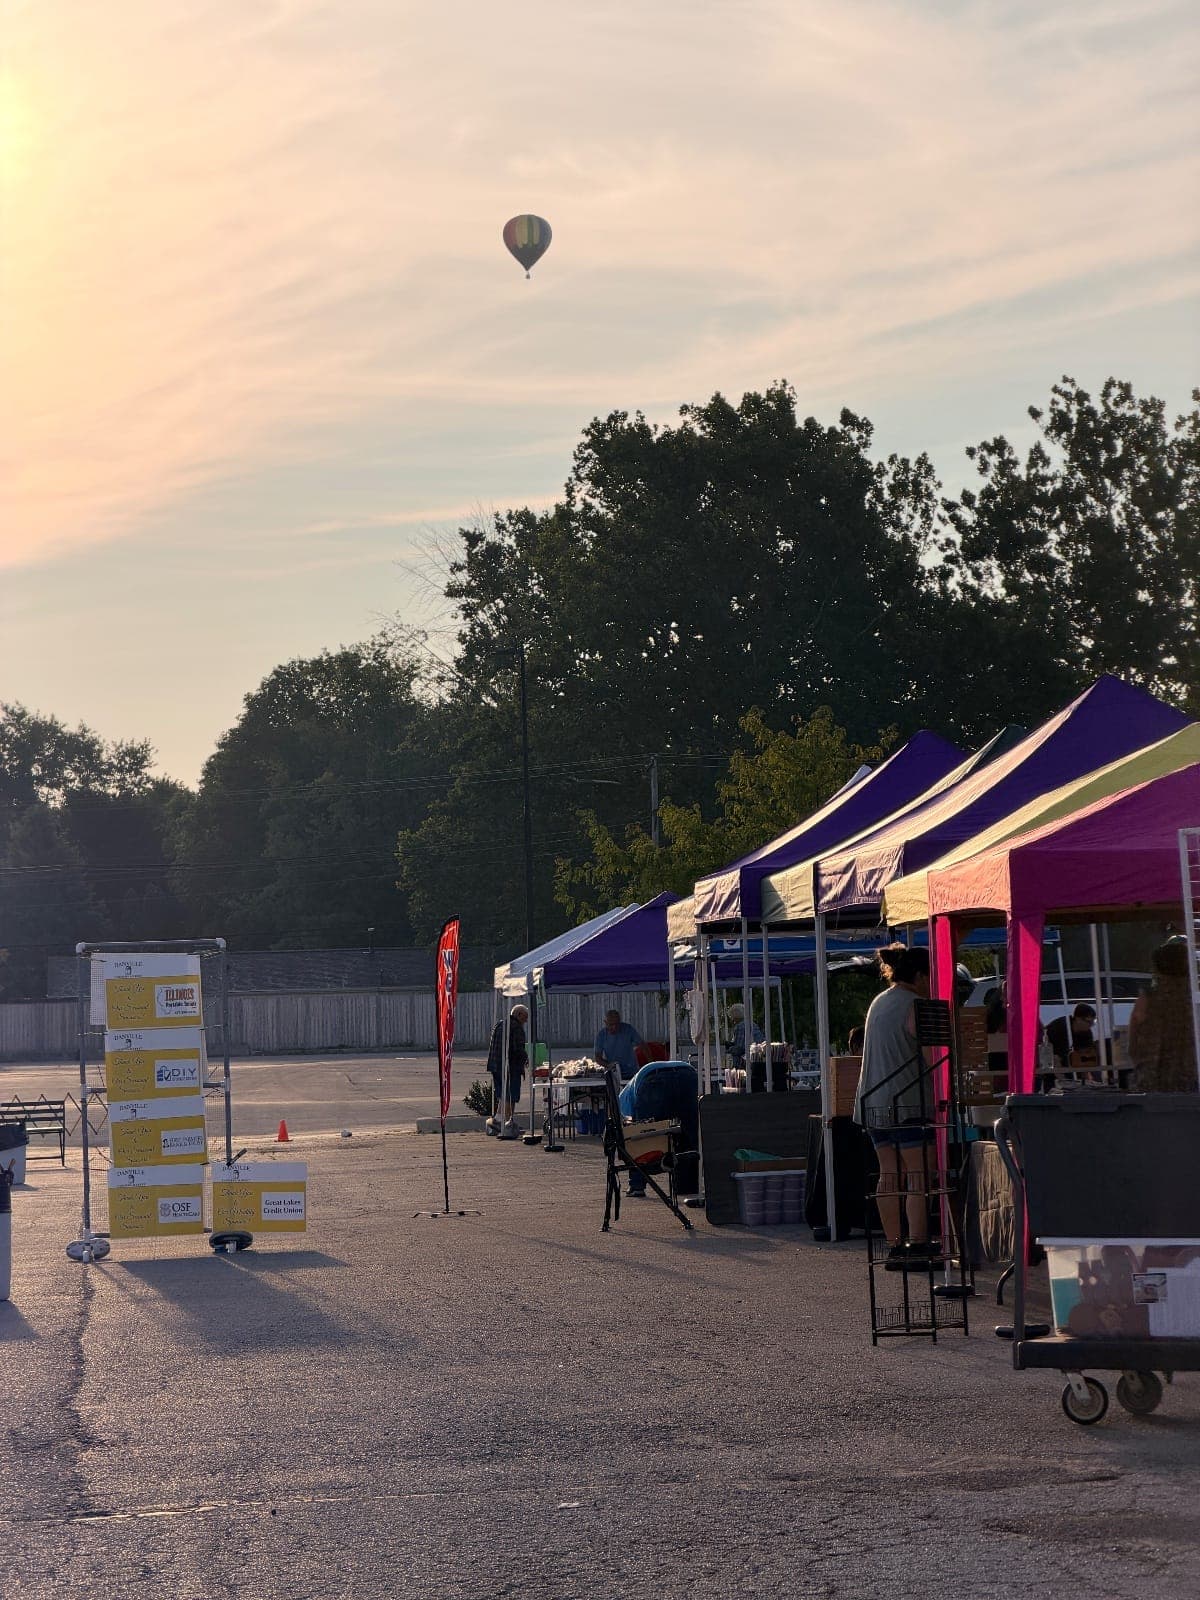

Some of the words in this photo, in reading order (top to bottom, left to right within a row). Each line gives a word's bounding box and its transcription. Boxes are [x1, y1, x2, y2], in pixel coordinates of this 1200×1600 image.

[164, 988, 195, 1001] ILLINOIS
[113, 1033, 143, 1041] DANVILLE
[171, 1068, 196, 1077] DIY
[172, 1202, 192, 1212] OSF
